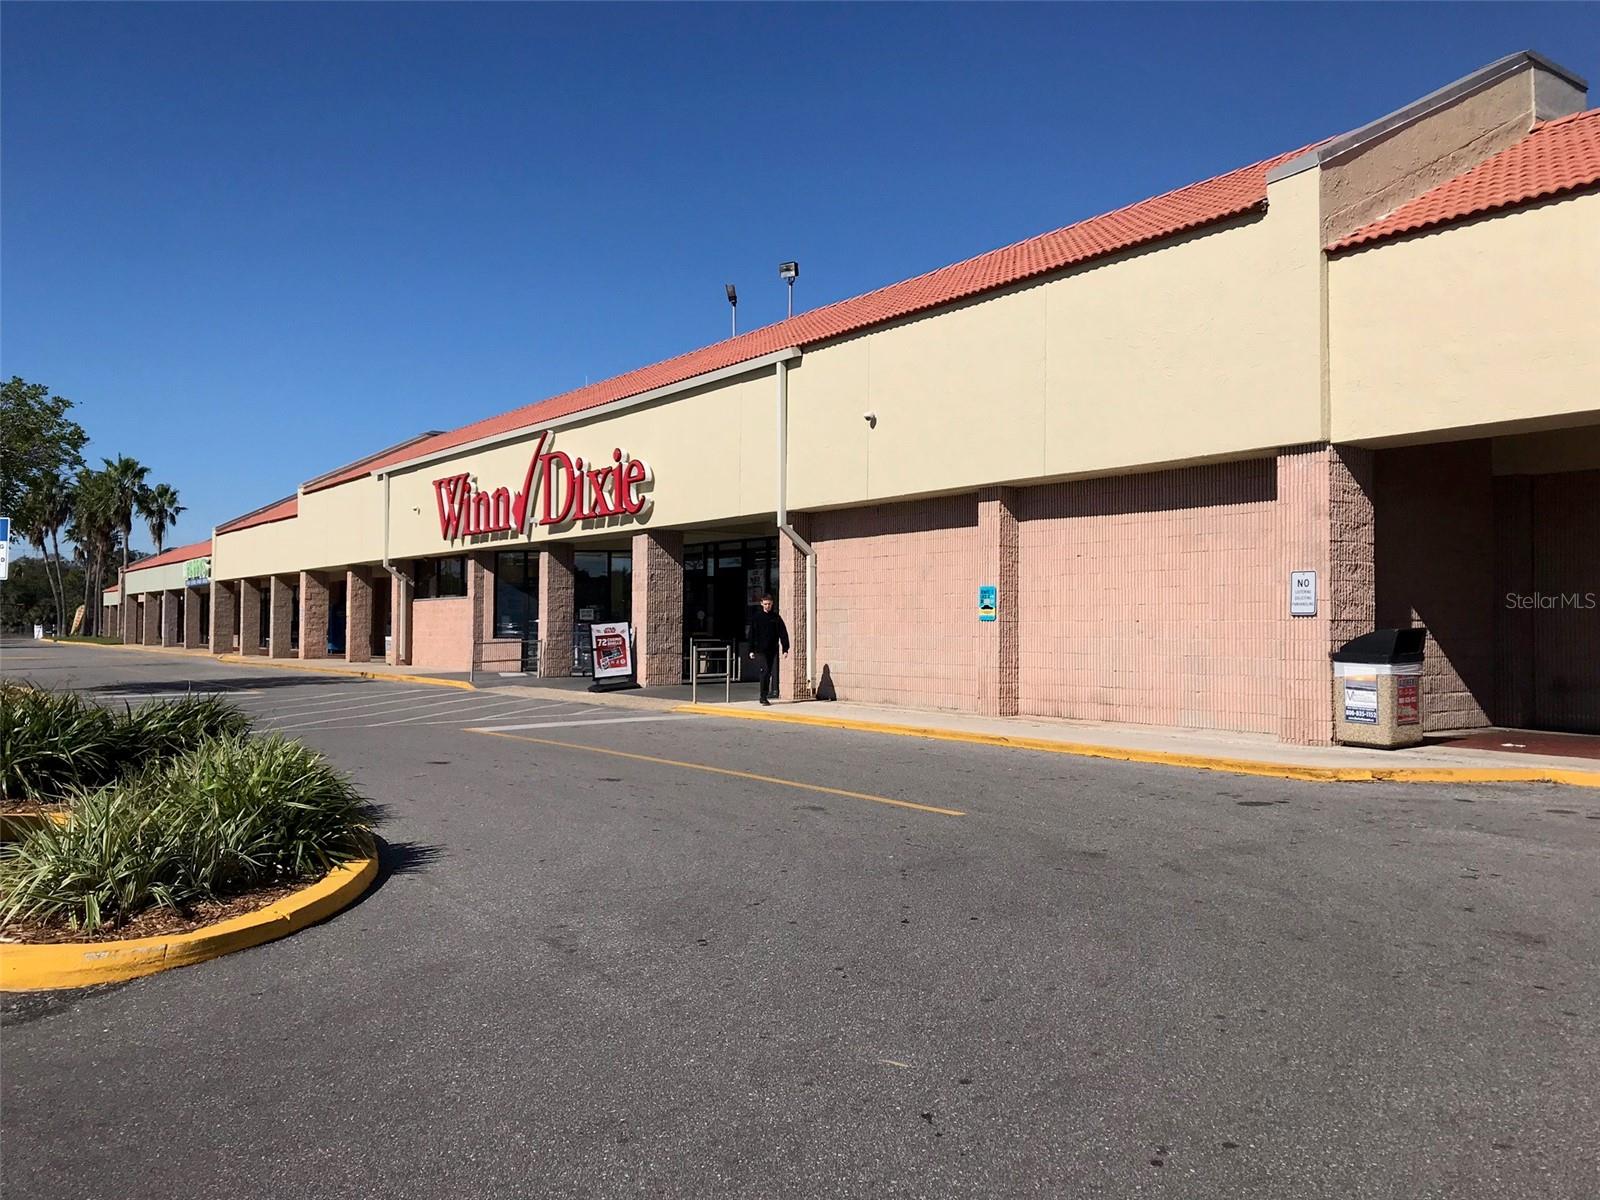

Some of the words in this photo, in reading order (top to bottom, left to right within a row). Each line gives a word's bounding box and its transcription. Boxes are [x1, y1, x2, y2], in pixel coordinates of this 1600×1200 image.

[432, 472, 512, 540] Winn
[539, 447, 648, 526] Dixie
[1297, 579, 1310, 588] NO
[597, 638, 608, 647] 72
